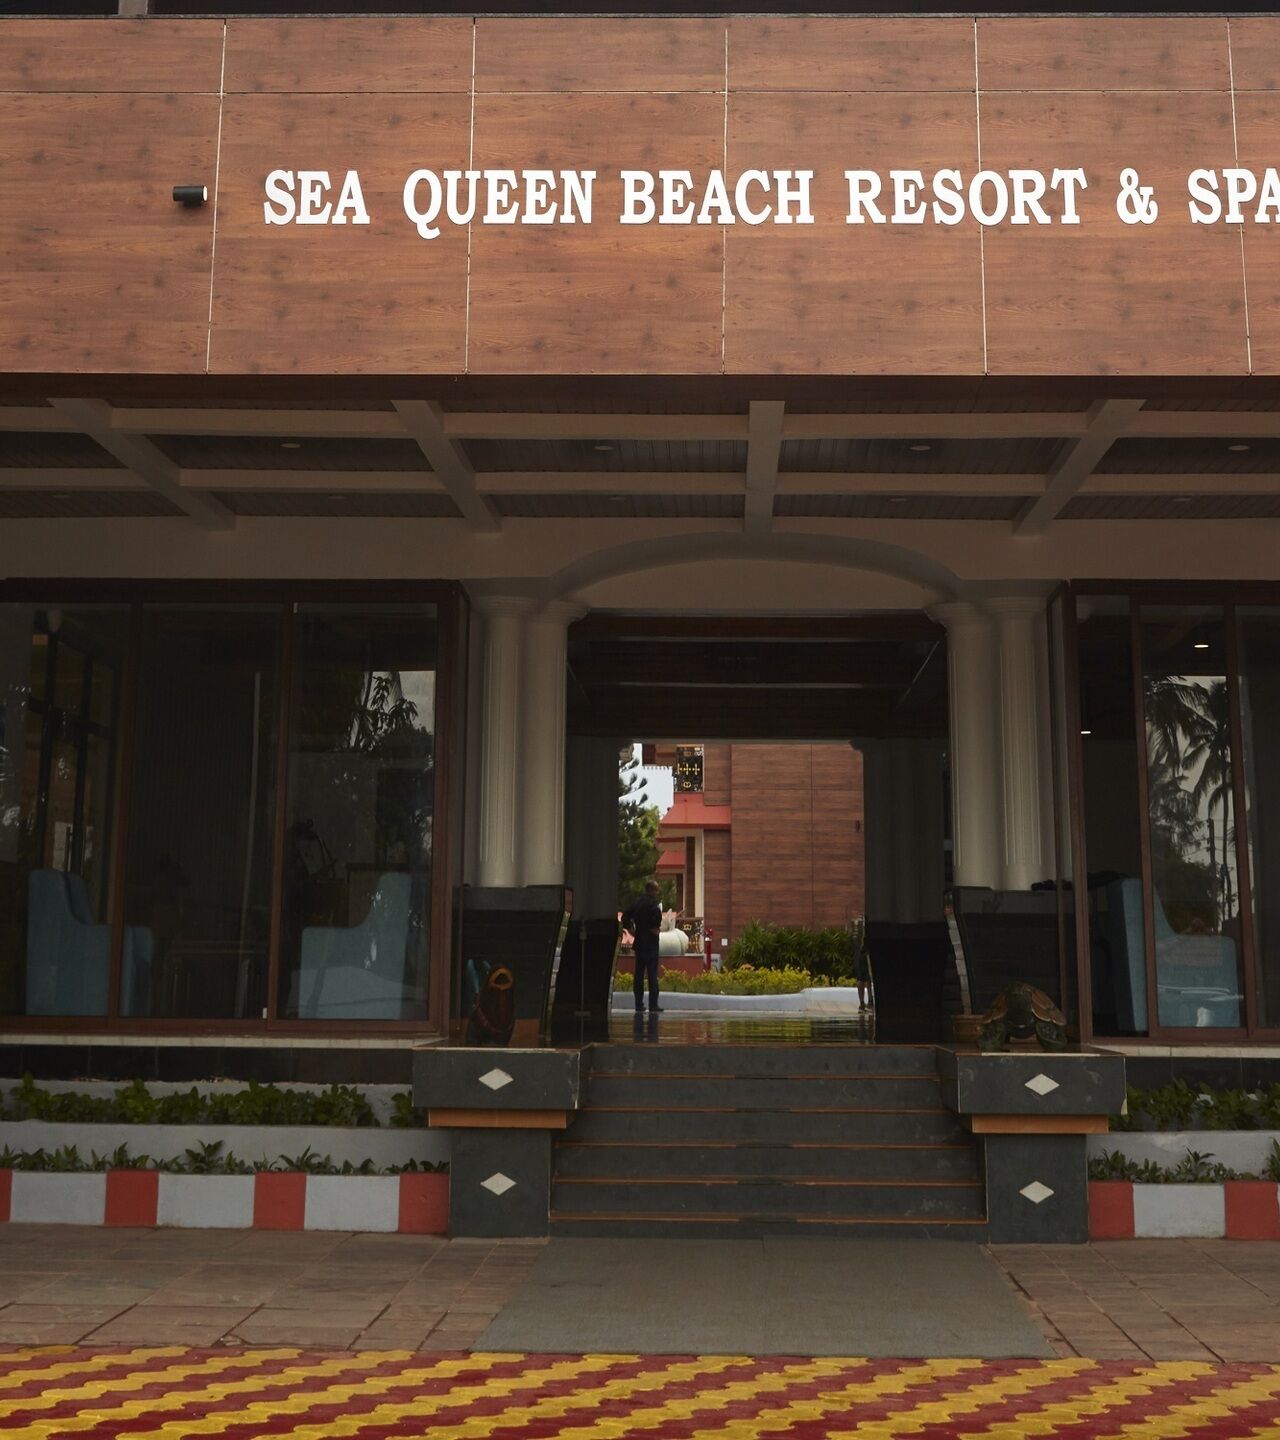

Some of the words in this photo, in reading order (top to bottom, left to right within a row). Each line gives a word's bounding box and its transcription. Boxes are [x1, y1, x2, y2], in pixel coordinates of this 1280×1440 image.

[263, 169, 370, 225] SEA
[403, 169, 596, 239] QUEEN
[620, 169, 815, 225] BEACH
[844, 167, 1087, 225] RESORT
[1116, 167, 1158, 225] &
